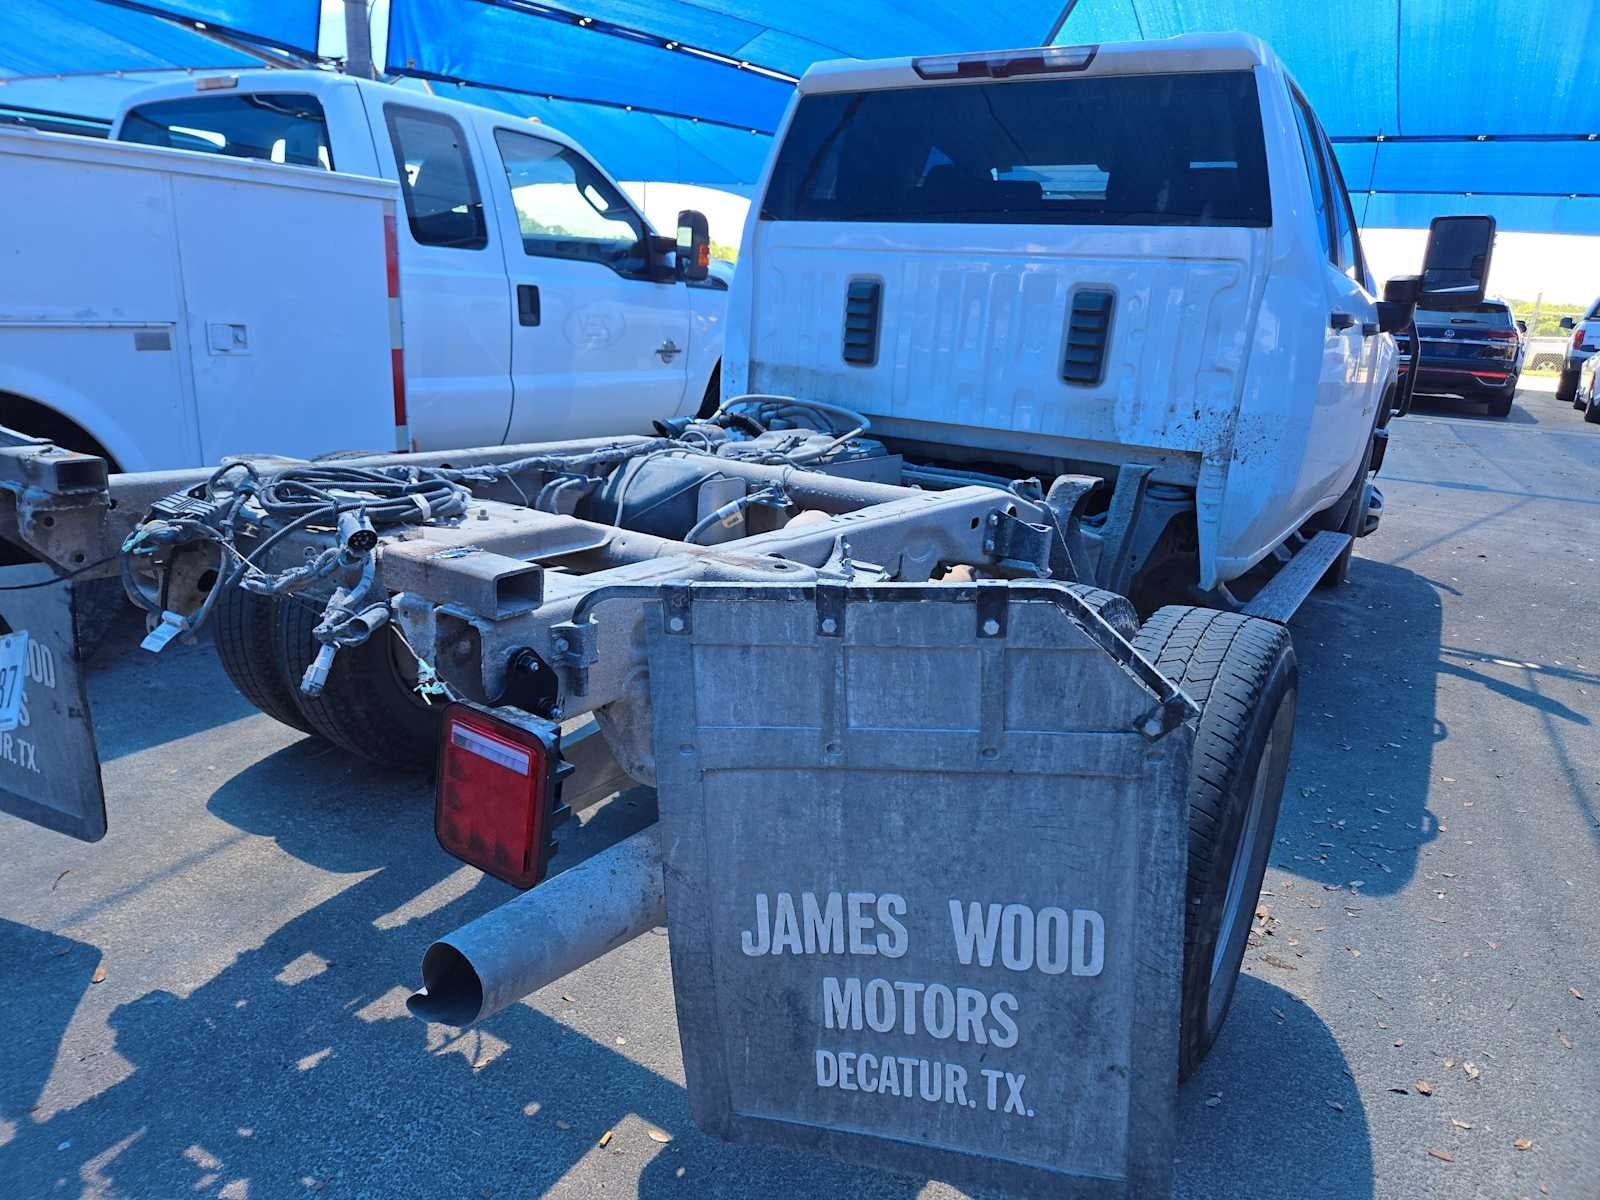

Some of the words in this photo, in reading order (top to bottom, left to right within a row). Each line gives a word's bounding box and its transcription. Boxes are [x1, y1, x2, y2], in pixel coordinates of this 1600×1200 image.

[26, 639, 55, 688] OD
[741, 891, 909, 958] JAMES
[948, 899, 1105, 977] WOOD
[822, 976, 1020, 1049] MOTORS
